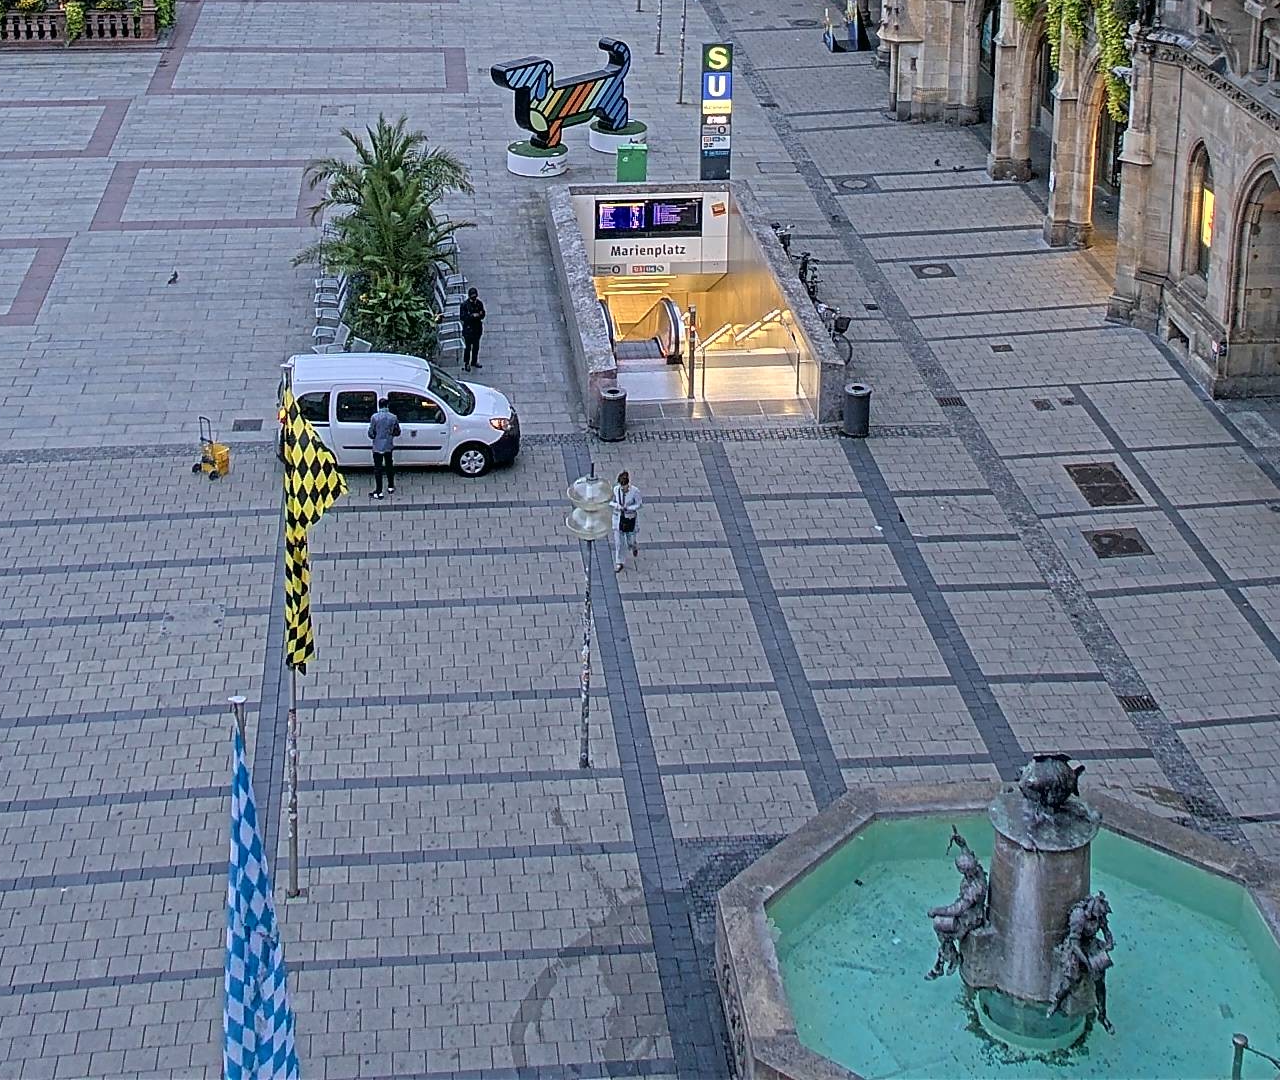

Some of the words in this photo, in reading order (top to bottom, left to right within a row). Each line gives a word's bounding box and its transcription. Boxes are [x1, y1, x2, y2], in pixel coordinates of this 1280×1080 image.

[708, 46, 728, 69] S
[708, 75, 726, 97] U
[610, 244, 687, 258] Marienplatz
